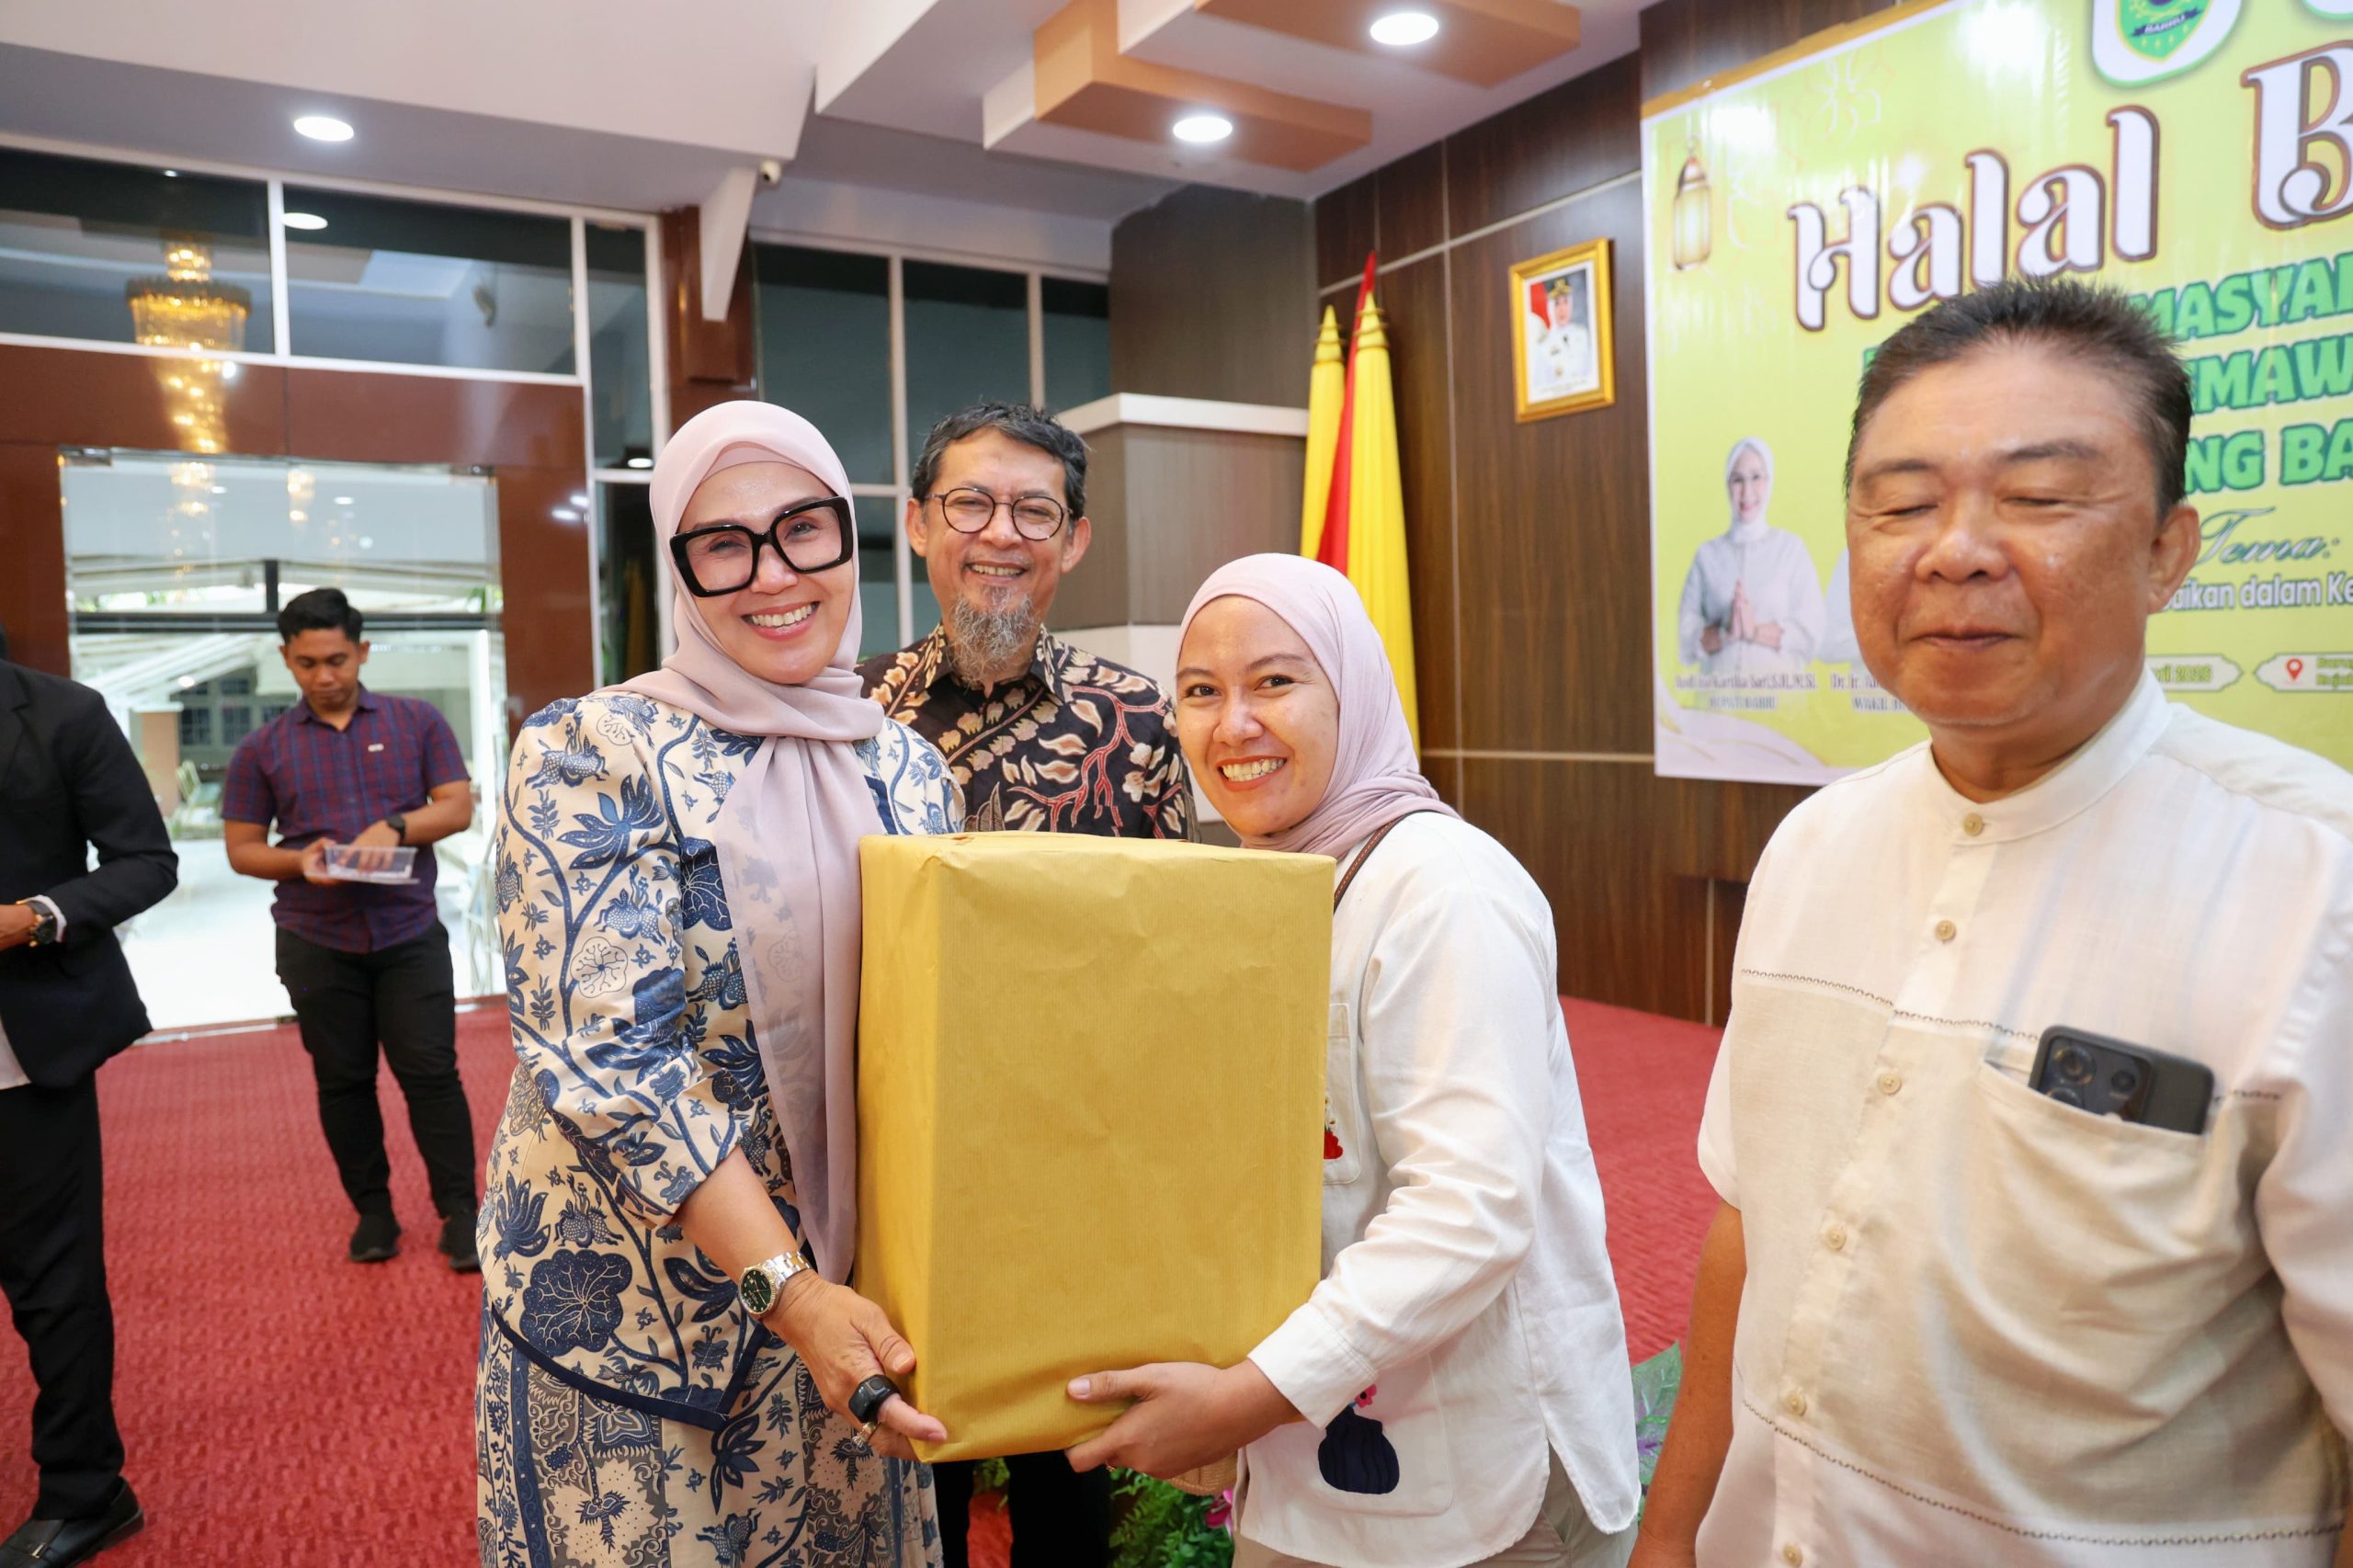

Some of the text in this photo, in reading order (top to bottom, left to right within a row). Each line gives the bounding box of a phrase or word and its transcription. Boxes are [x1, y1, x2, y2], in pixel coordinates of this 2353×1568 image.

[1787, 105, 2160, 332] Halal
[2123, 251, 2353, 342] MASYA
[2186, 333, 2353, 414] MAW
[2196, 506, 2340, 565] Tema:
[2165, 577, 2235, 612] aikan
[2240, 573, 2323, 609] dalam
